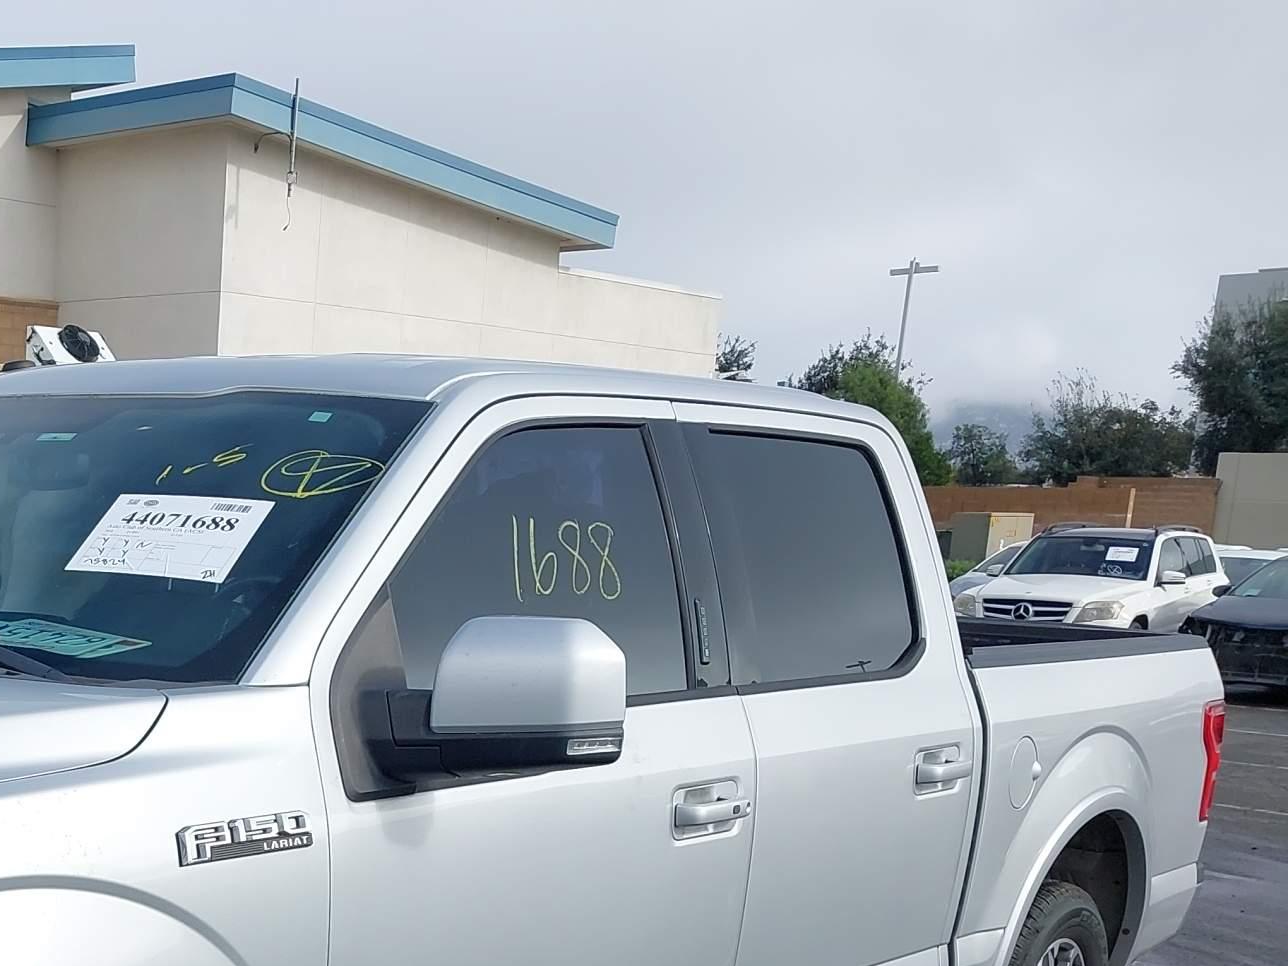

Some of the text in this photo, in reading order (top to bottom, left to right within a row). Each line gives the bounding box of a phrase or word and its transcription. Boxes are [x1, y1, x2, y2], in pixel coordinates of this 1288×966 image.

[121, 511, 240, 532] 44071688
[512, 515, 621, 602] 1688
[264, 836, 310, 850] LARIAT
